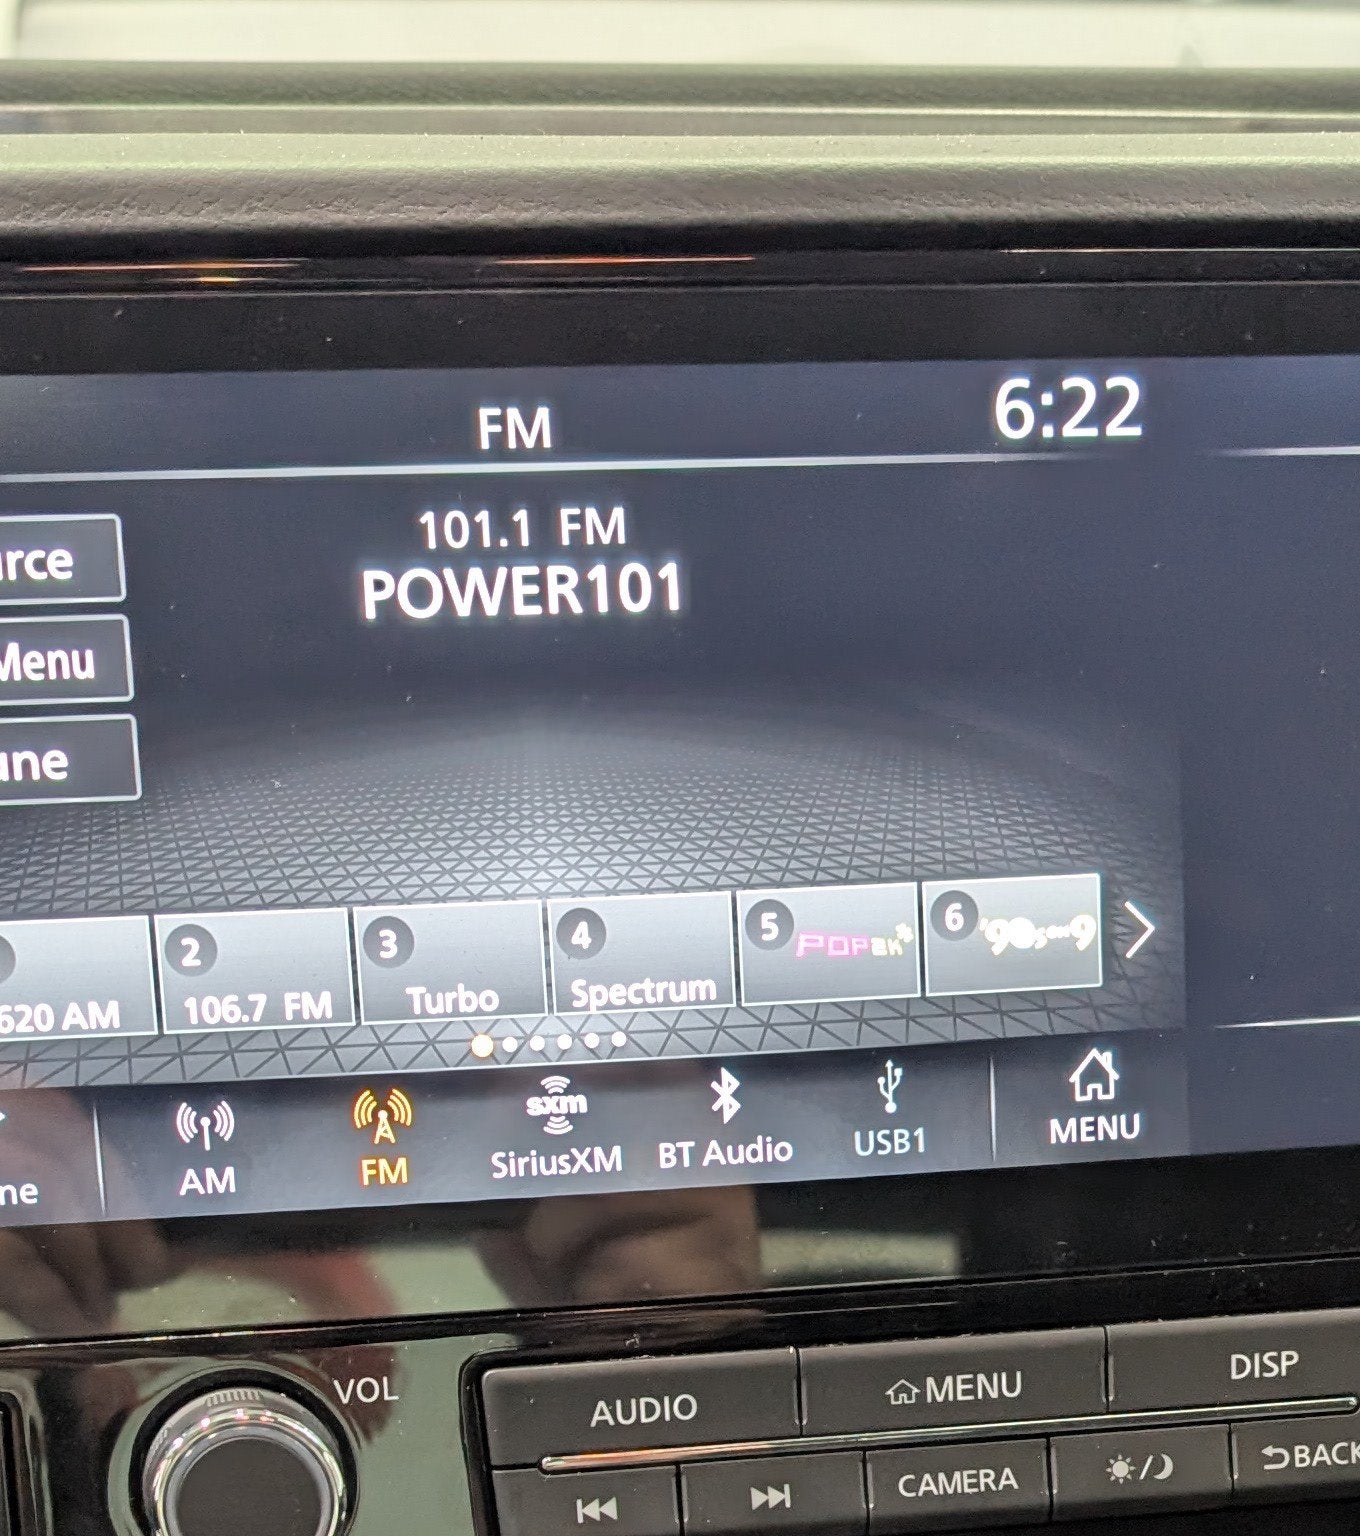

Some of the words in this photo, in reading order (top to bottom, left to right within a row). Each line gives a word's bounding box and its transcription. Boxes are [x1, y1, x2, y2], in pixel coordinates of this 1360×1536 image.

[995, 376, 1142, 440] 6:22
[477, 406, 552, 450] FM
[419, 509, 530, 550] 101.1
[561, 506, 626, 547] FM
[362, 562, 682, 620] POWER101
[760, 912, 779, 941] 5
[944, 903, 964, 932] 6
[379, 930, 398, 958] 3
[571, 921, 592, 949] 4
[181, 939, 202, 967] 2
[184, 994, 268, 1025] 106.7
[284, 991, 333, 1021] FM
[406, 985, 500, 1016] Turbo
[570, 975, 717, 1012] Spectrum
[62, 1000, 120, 1030] AM
[854, 1127, 926, 1156] USB1
[1049, 1113, 1140, 1144] MENU
[491, 1147, 623, 1179] SiriusXM
[659, 1141, 697, 1168] BT
[702, 1136, 793, 1164] Audio
[179, 1167, 236, 1196] AM
[361, 1157, 408, 1187] FM
[1230, 1352, 1299, 1380] DISP
[333, 1377, 399, 1404] VOL
[926, 1371, 1022, 1403] MENU
[590, 1394, 698, 1427] AUDIO
[899, 1467, 1018, 1498] CAMERA
